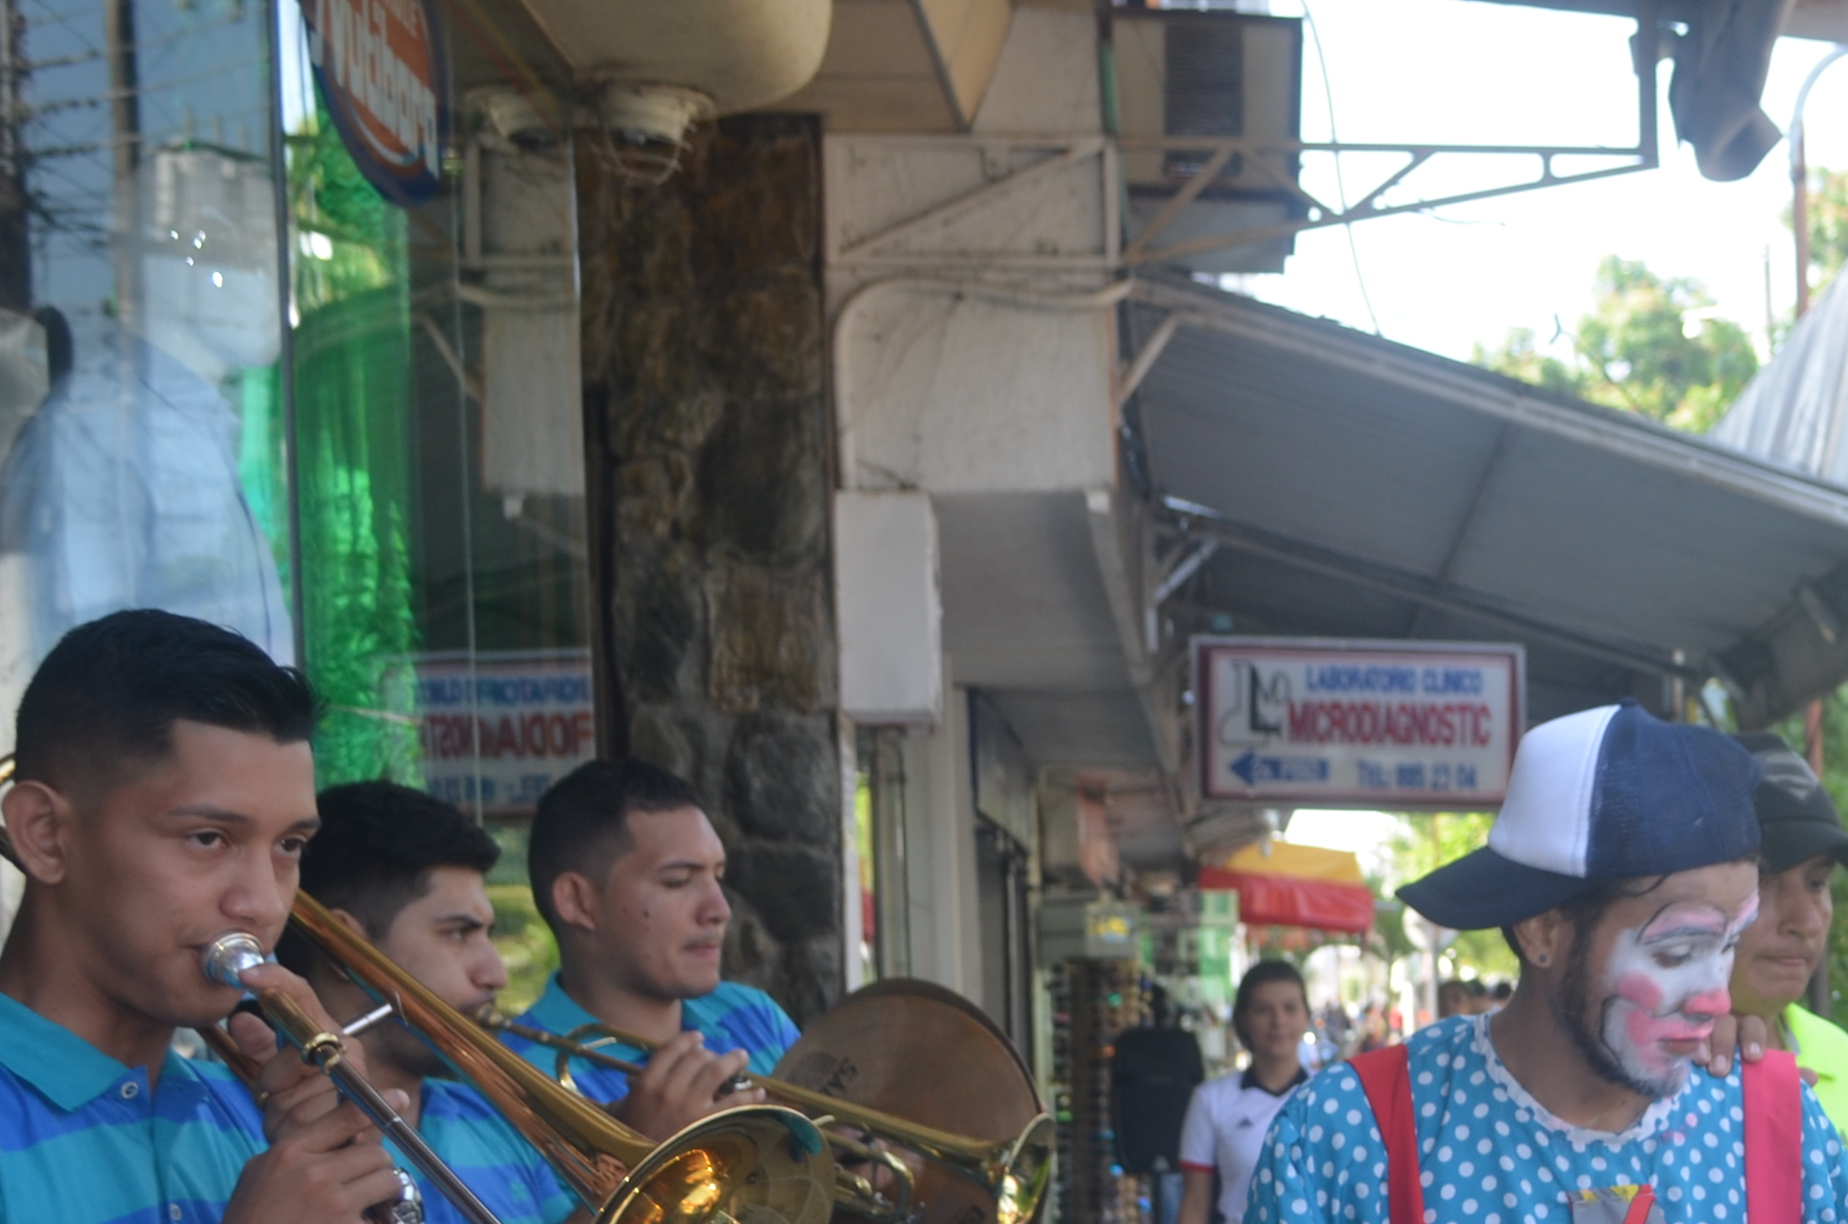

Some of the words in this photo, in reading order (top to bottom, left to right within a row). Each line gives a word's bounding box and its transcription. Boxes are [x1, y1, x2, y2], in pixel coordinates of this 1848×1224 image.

[1305, 664, 1416, 693] LABORATORIO
[1421, 667, 1483, 695] CLINICO
[1287, 699, 1492, 746] MICRODIAGNOSTIC
